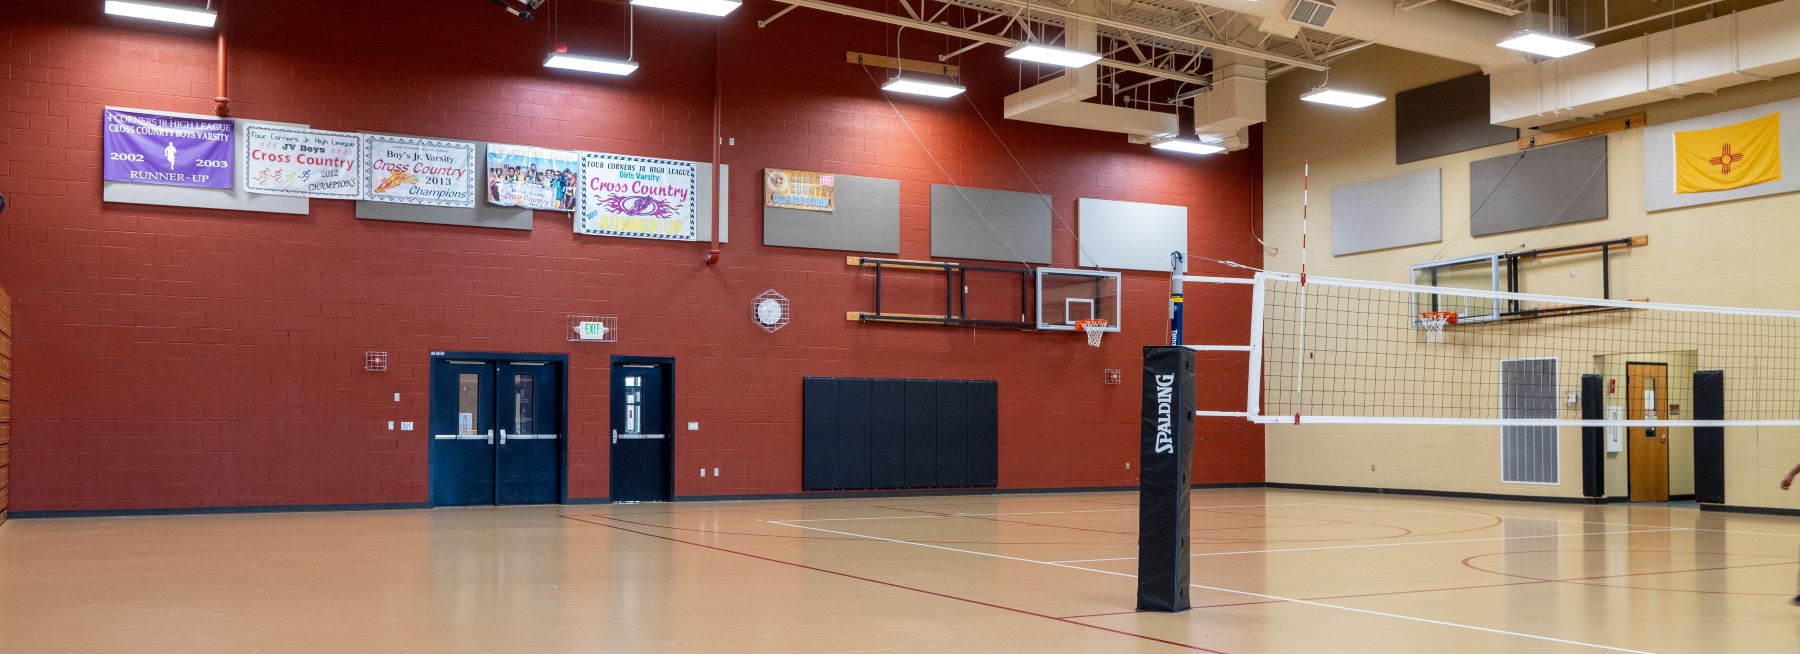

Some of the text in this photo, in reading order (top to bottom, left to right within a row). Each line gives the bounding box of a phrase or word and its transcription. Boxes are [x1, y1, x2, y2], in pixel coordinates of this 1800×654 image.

[107, 113, 231, 132] 4 CORNERS JR HIGH LEAGUE
[108, 124, 135, 134] CROSS
[176, 129, 196, 139] BOYS
[197, 131, 230, 142] VARSITY
[270, 133, 300, 143] Corners
[314, 137, 329, 146] High
[331, 138, 356, 148] League
[282, 143, 326, 154] JV Boys
[110, 152, 144, 162] 2002
[195, 159, 228, 168] 2003
[251, 149, 354, 171] Cross Country
[386, 150, 411, 160] Boy's
[425, 153, 455, 165] Varsity
[321, 169, 339, 178] 2012
[372, 159, 466, 180] Cross Country
[587, 160, 691, 177] FOUR CORNERS JR HIGH LEAGUE
[425, 176, 452, 186] 2013
[619, 171, 660, 182] Girls Varsity
[308, 178, 356, 192] CHAMPIONS
[409, 185, 467, 199] Champions
[590, 177, 688, 202] Cross Country
[664, 219, 684, 234] UP
[584, 322, 602, 334] EXIT
[1154, 372, 1175, 454] SPALDING
